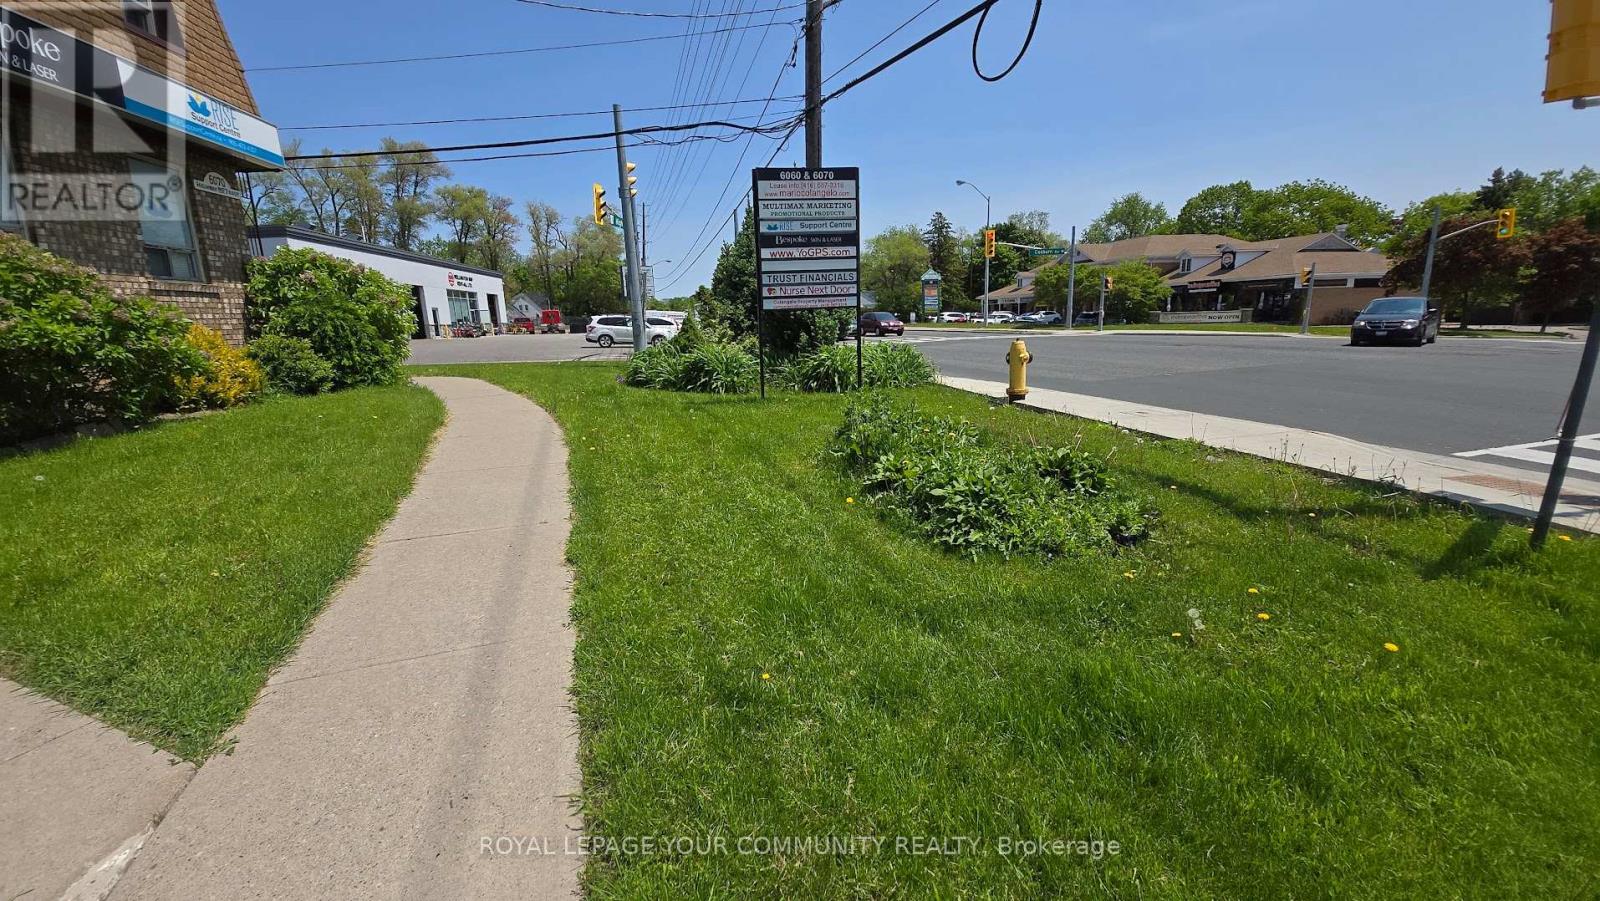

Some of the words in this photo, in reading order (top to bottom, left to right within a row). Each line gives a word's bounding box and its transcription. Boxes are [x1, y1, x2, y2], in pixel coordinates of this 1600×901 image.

[12, 54, 21, 68] &
[23, 58, 60, 82] LASER
[210, 99, 240, 130] RISE
[191, 111, 218, 131] Support
[219, 123, 241, 138] Centre
[780, 171, 801, 180] 6060
[803, 171, 811, 180] &
[812, 171, 835, 180] 6070
[800, 222, 828, 230] Support
[829, 221, 852, 229] Centre
[775, 235, 808, 245] Bespoke
[767, 275, 797, 283] TRUST
[799, 272, 855, 282] FINANCIALS
[780, 286, 806, 295] Nurse
[807, 286, 829, 294] Next
